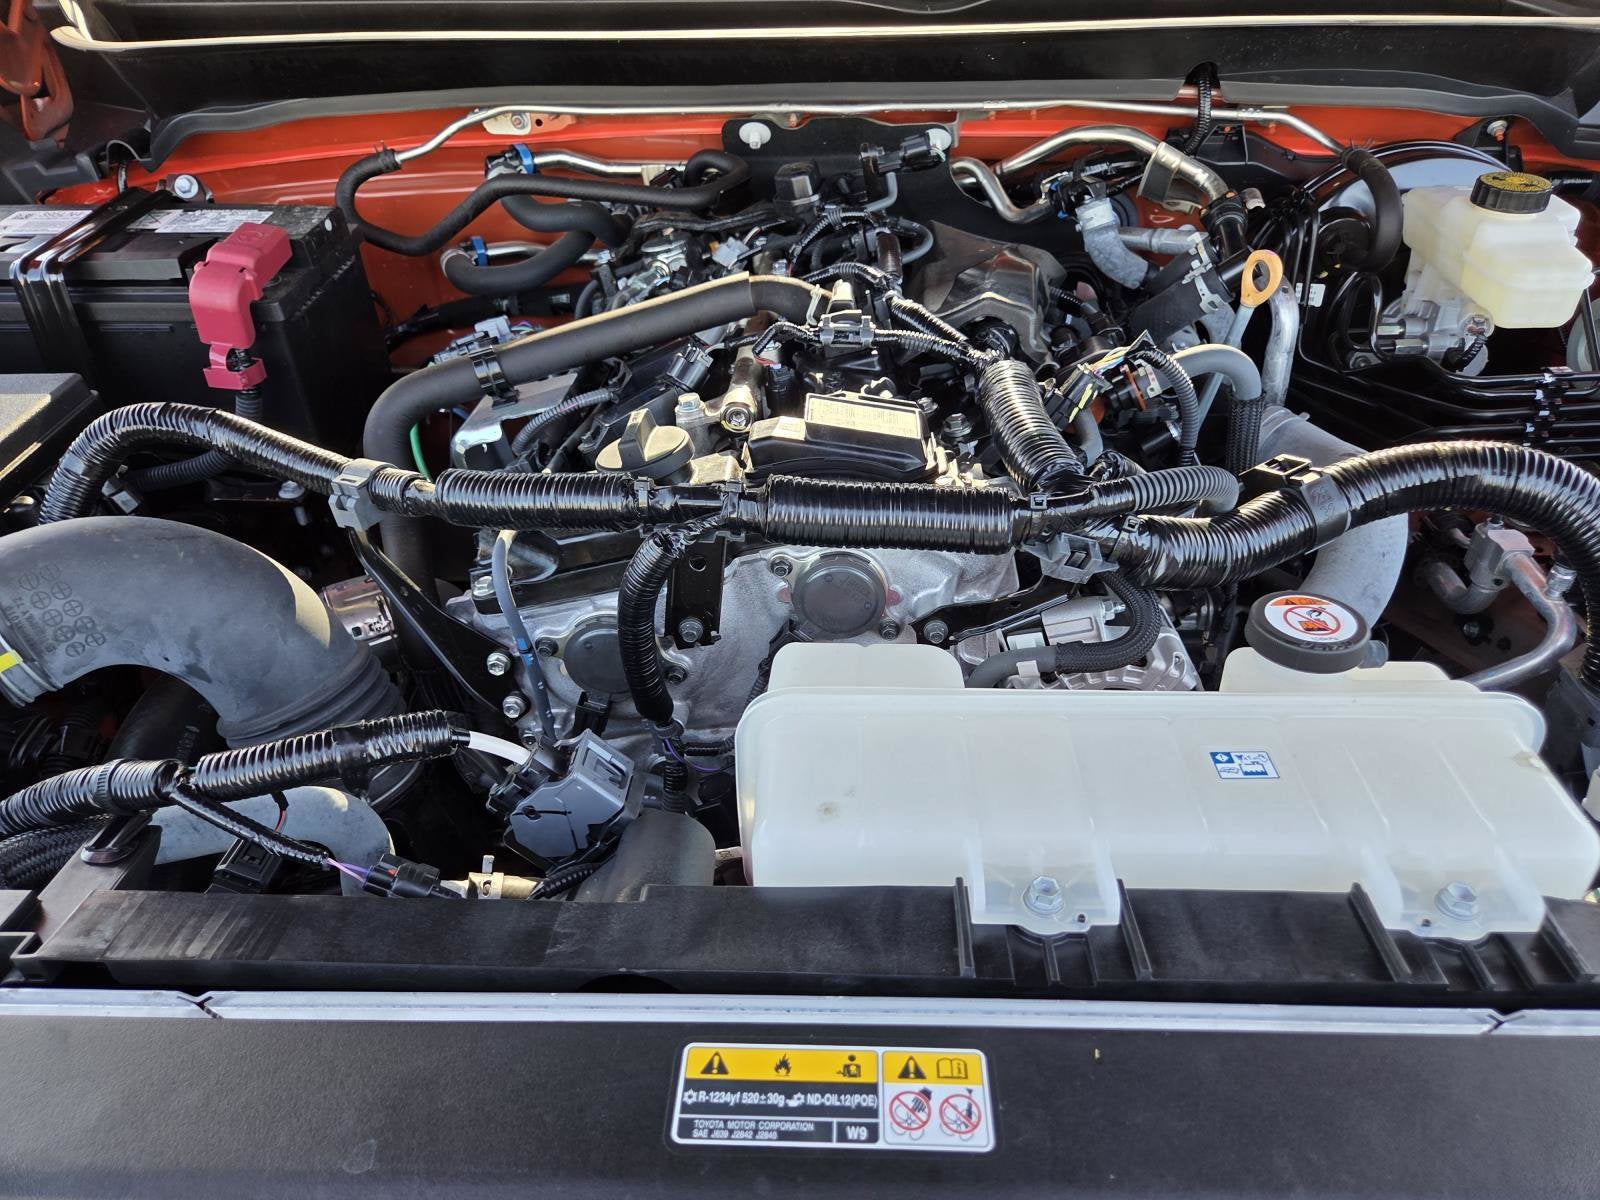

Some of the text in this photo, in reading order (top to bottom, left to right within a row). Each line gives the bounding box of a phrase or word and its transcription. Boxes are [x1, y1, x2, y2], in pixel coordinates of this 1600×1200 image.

[700, 1091, 741, 1106] R-1234yf
[693, 1119, 815, 1131] TOYOTA MOTOR CORPORATION
[692, 1129, 708, 1138] SAE
[846, 1125, 868, 1141] W9
